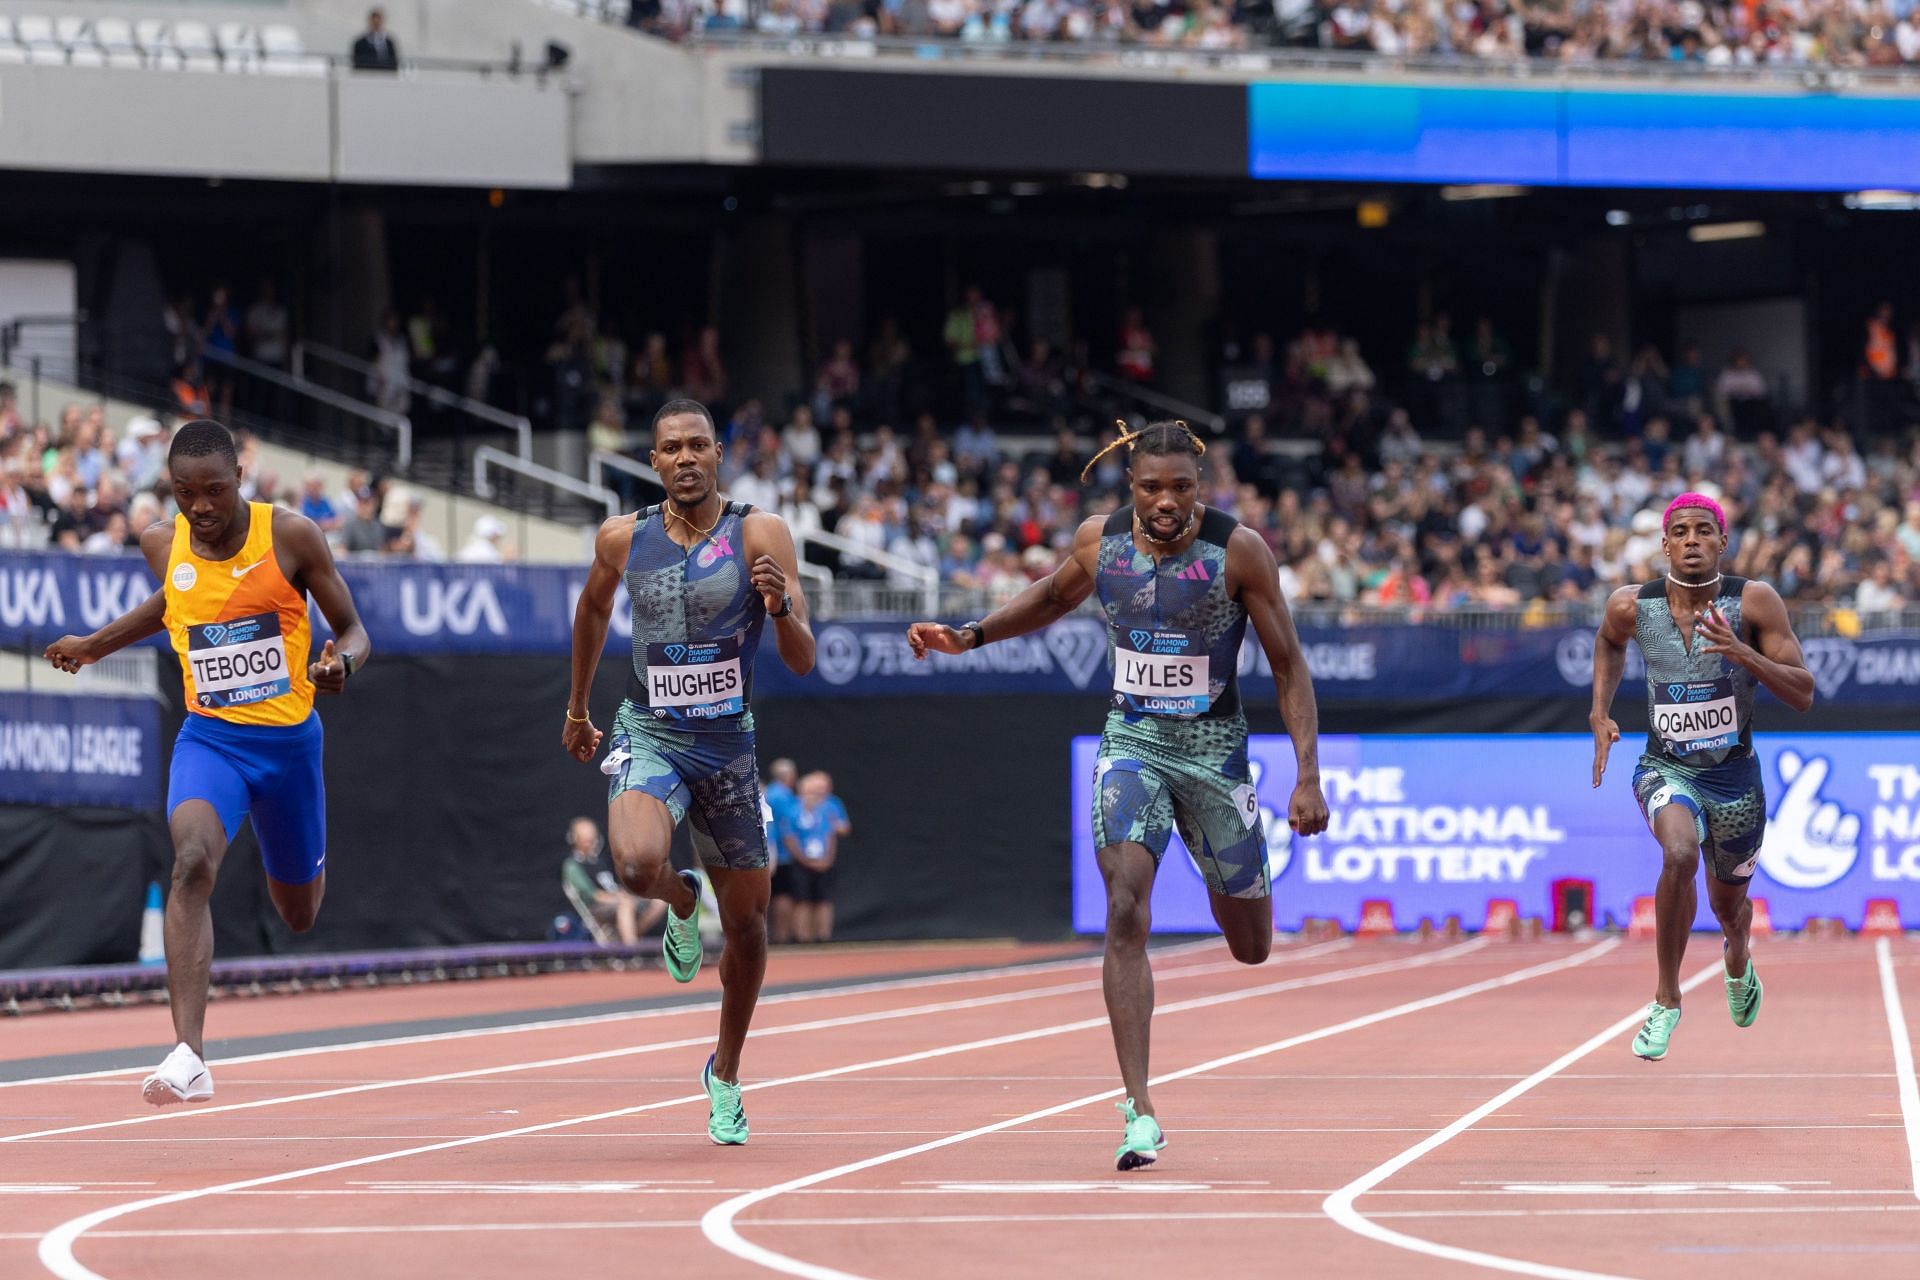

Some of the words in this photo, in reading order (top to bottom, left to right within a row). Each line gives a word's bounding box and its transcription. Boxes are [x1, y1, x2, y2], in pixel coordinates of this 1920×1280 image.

[0, 569, 66, 627] UKA
[402, 579, 509, 635] UKA
[688, 647, 721, 656] DIAMOND
[1152, 646, 1181, 654] LEAGUE
[1153, 639, 1189, 647] DIAMOND
[193, 647, 281, 683] TEBOGO
[687, 655, 715, 663] LEAGUE
[653, 668, 737, 697] HUGHES
[1125, 659, 1194, 688] LYLES
[229, 684, 279, 703] LONDON
[1686, 693, 1712, 702] LEAGUE
[1687, 686, 1717, 696] DIAMOND
[686, 701, 733, 718] LONDON
[1144, 698, 1196, 709] LONDON
[1658, 705, 1733, 733] OGANDO
[71, 723, 143, 776] LEAGUE
[1685, 736, 1729, 752] LONDON
[1247, 793, 1256, 813] 6
[1873, 805, 1920, 839] N
[1306, 846, 1538, 882] LOTTERY
